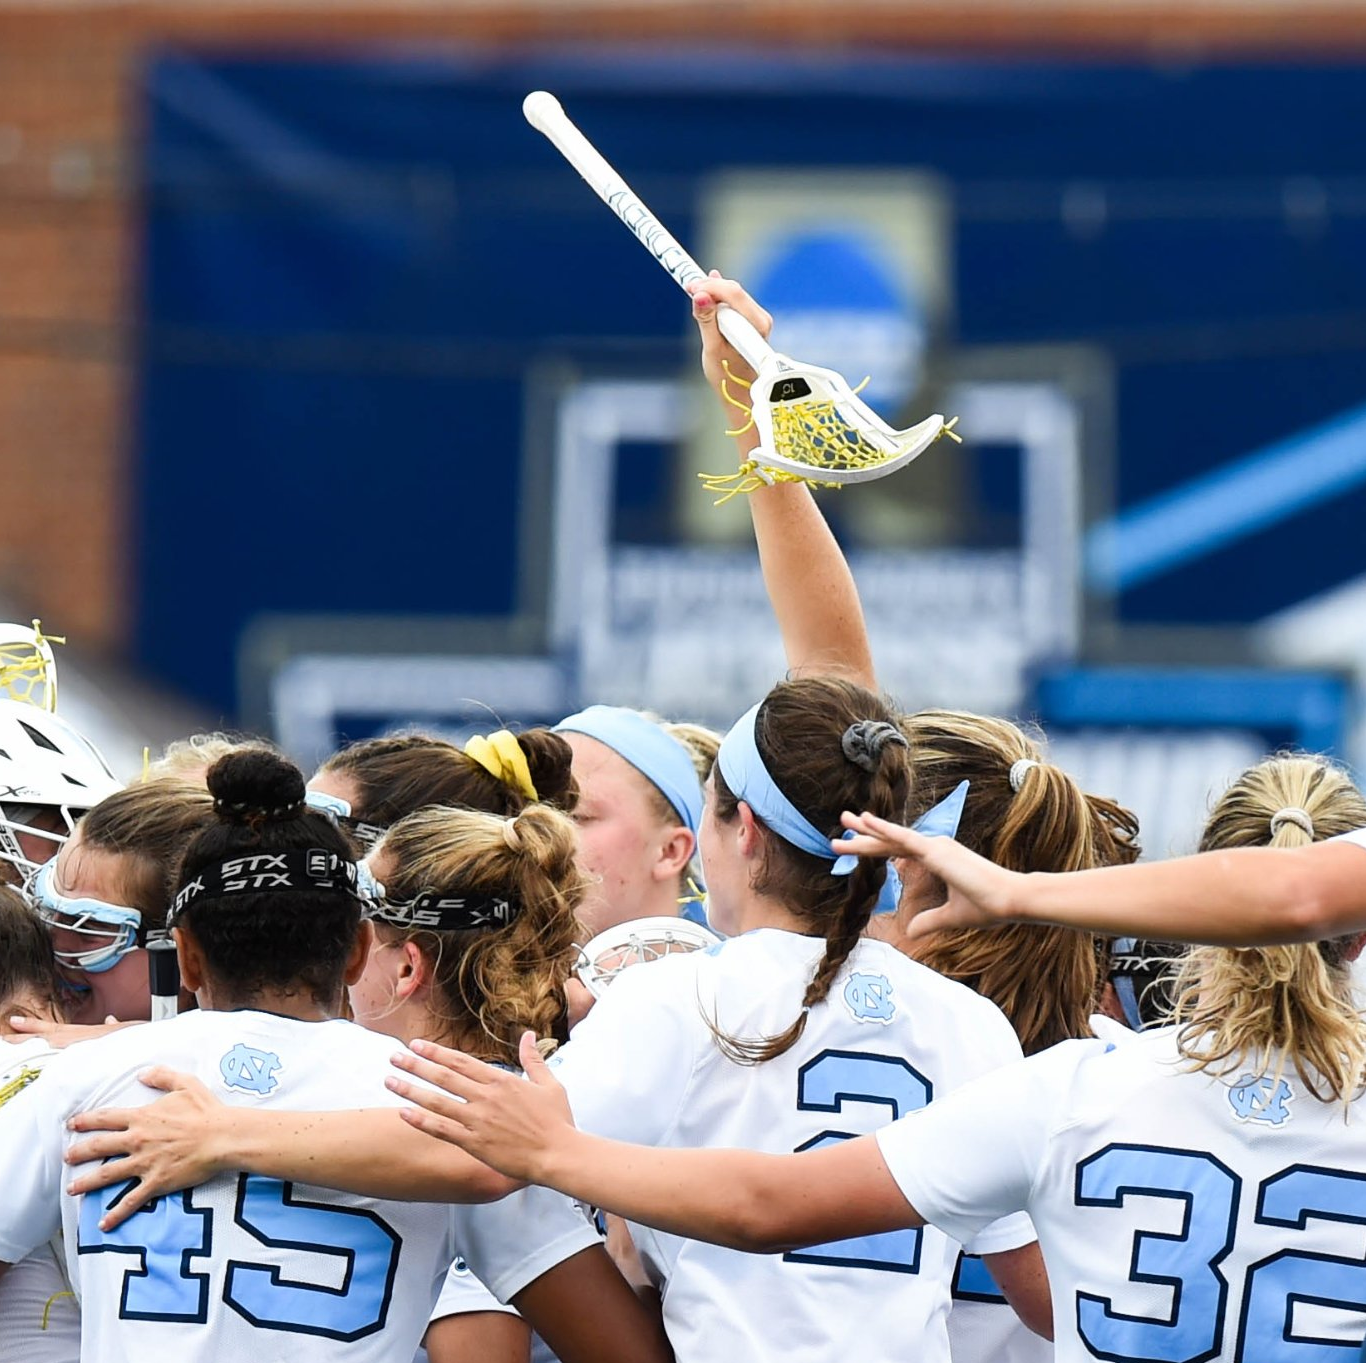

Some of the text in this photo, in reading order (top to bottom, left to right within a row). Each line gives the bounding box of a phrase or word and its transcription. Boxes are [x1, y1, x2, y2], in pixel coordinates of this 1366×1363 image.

[221, 854, 288, 879] STX
[176, 875, 206, 911] STX
[223, 873, 292, 892] STX
[77, 1157, 403, 1343] 45
